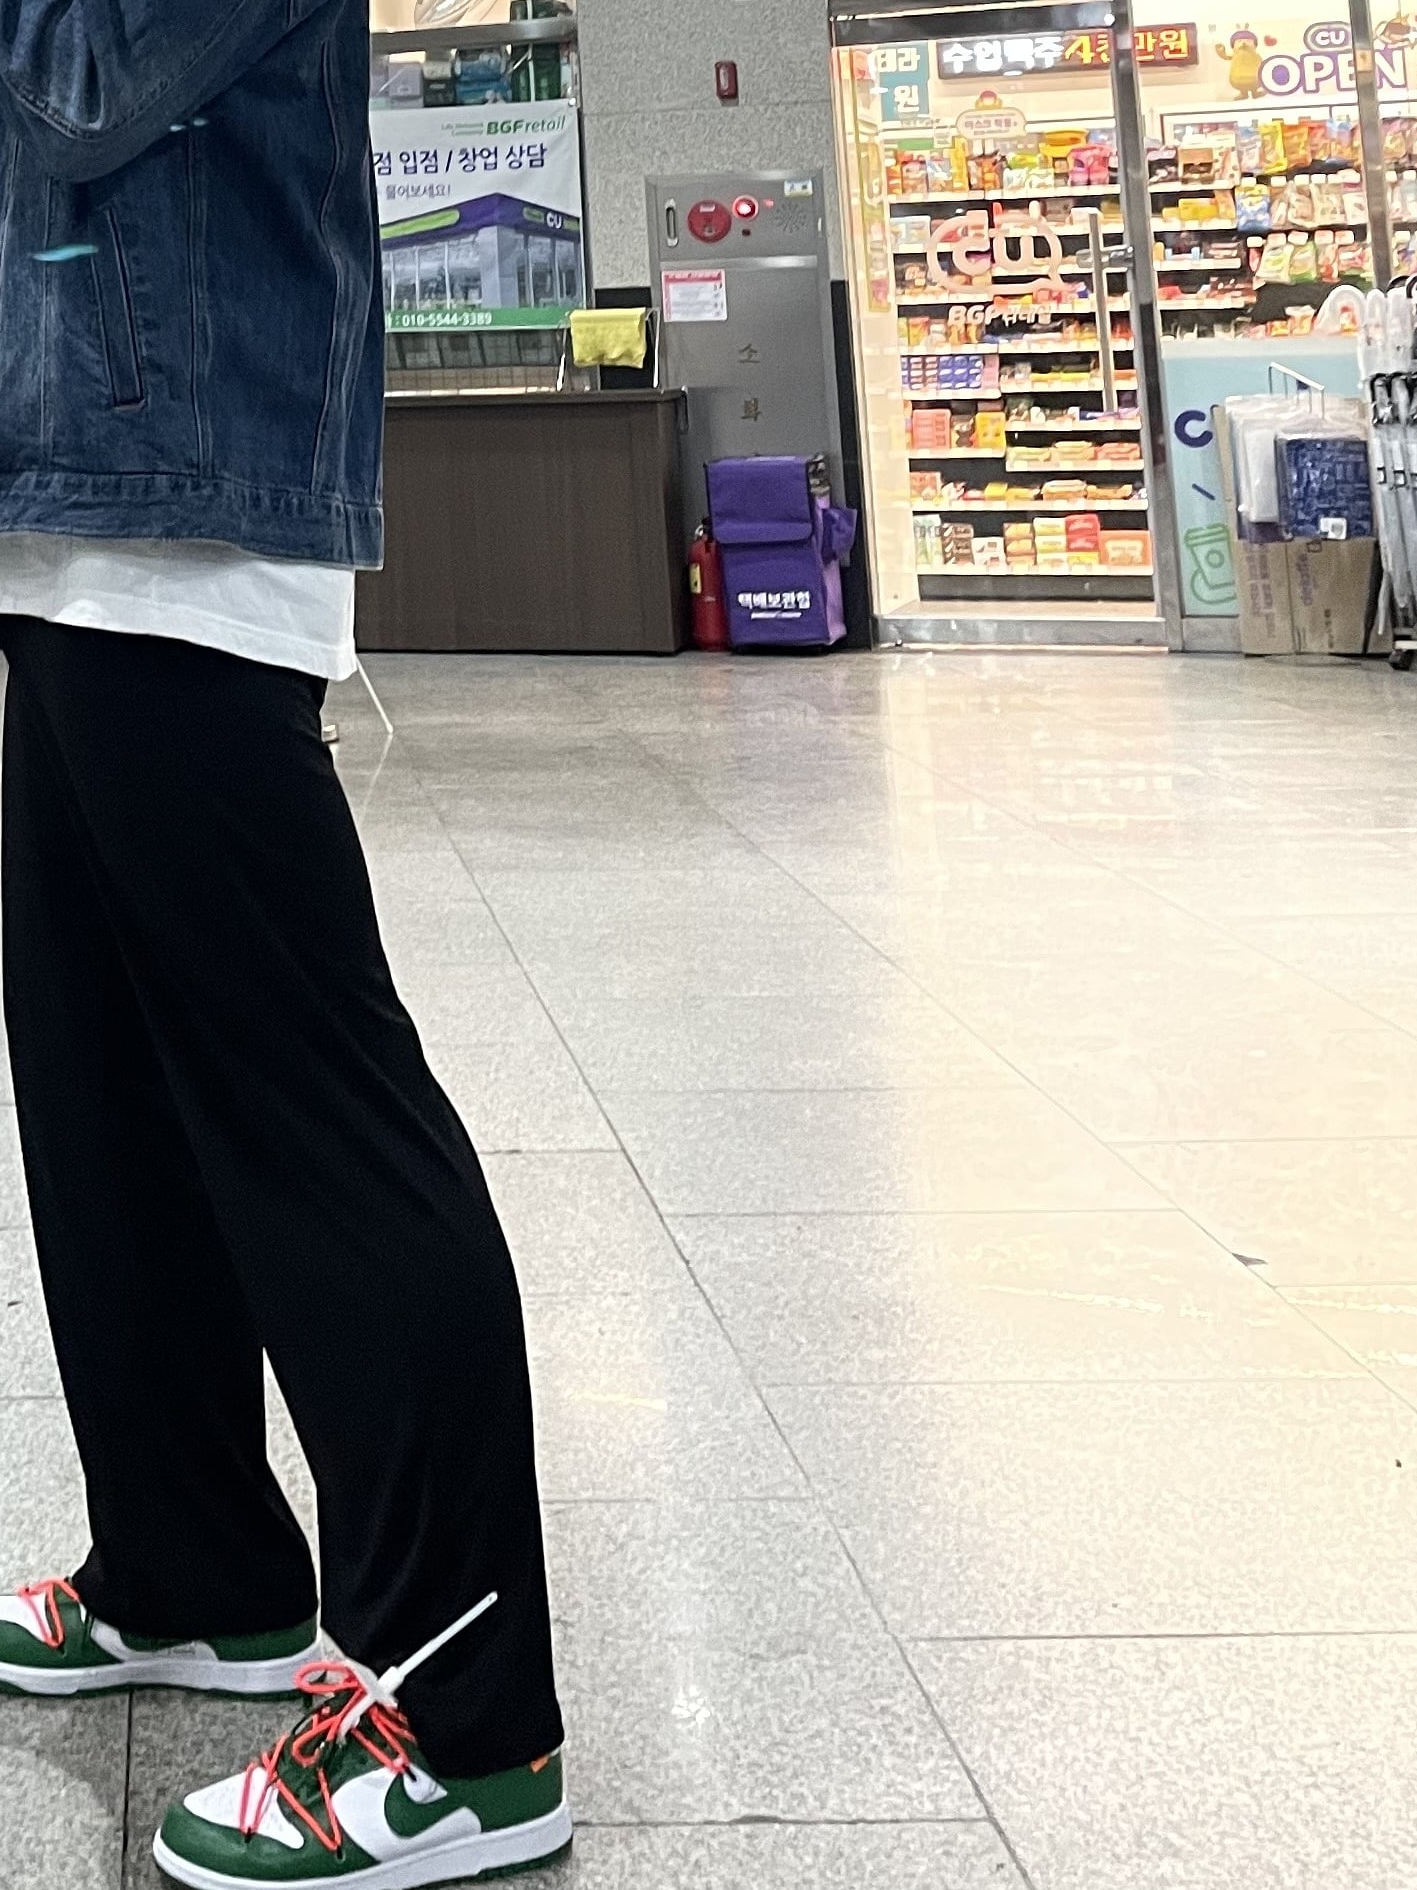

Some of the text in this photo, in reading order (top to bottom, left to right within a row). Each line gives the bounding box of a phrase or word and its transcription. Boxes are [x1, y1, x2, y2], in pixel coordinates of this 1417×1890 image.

[1315, 31, 1345, 46] CU
[1260, 48, 1407, 95] OPEN
[399, 149, 439, 175] 입점
[445, 149, 453, 173] /
[459, 146, 498, 172] 창업
[505, 142, 547, 170] 상담
[546, 212, 562, 228] CU
